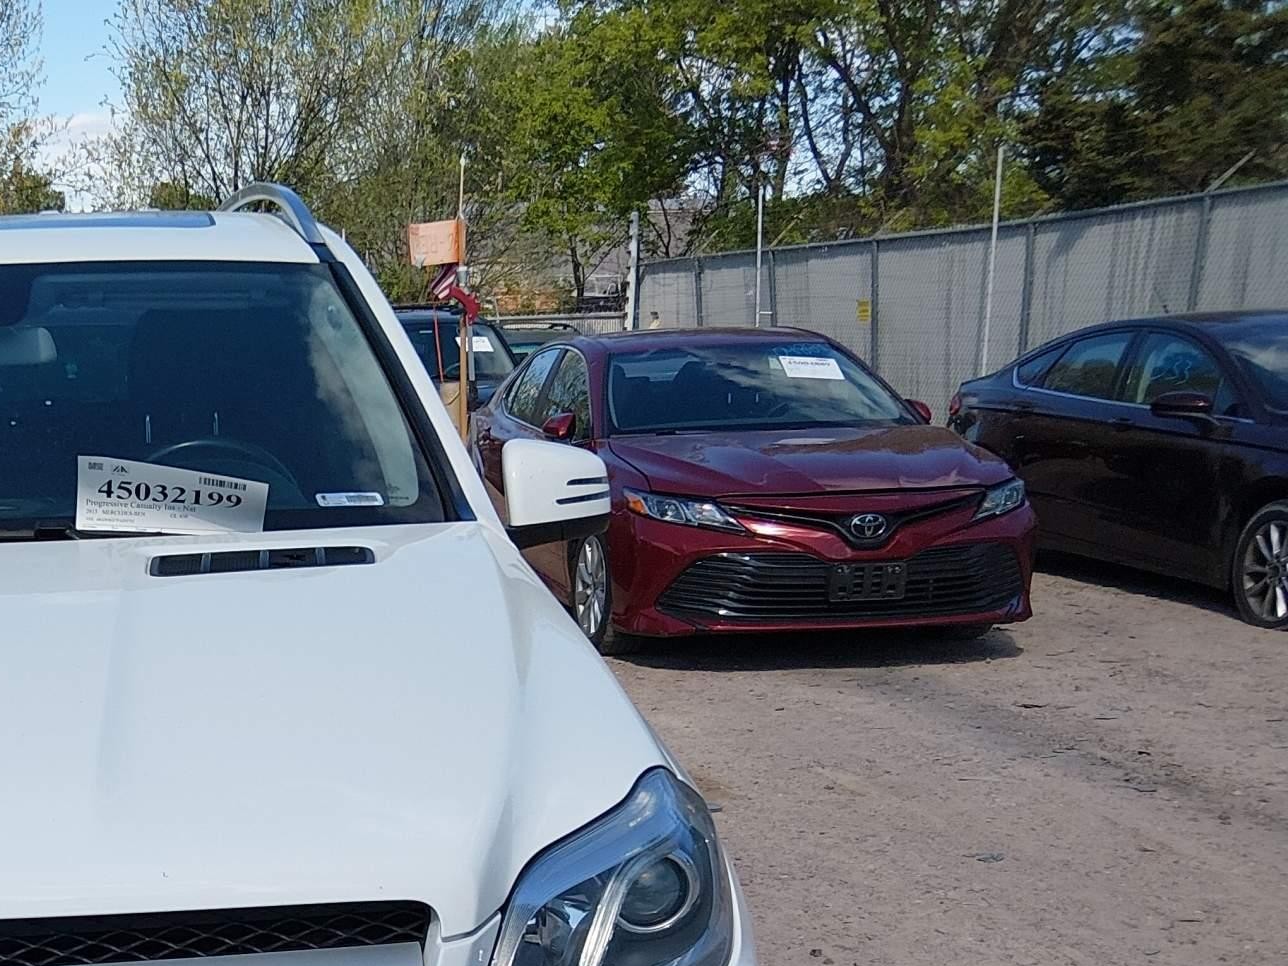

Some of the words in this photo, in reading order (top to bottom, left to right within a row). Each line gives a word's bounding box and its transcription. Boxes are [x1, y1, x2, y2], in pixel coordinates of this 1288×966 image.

[85, 498, 129, 509] Progressive
[130, 501, 161, 512] Casualty
[97, 479, 243, 509] 45032199
